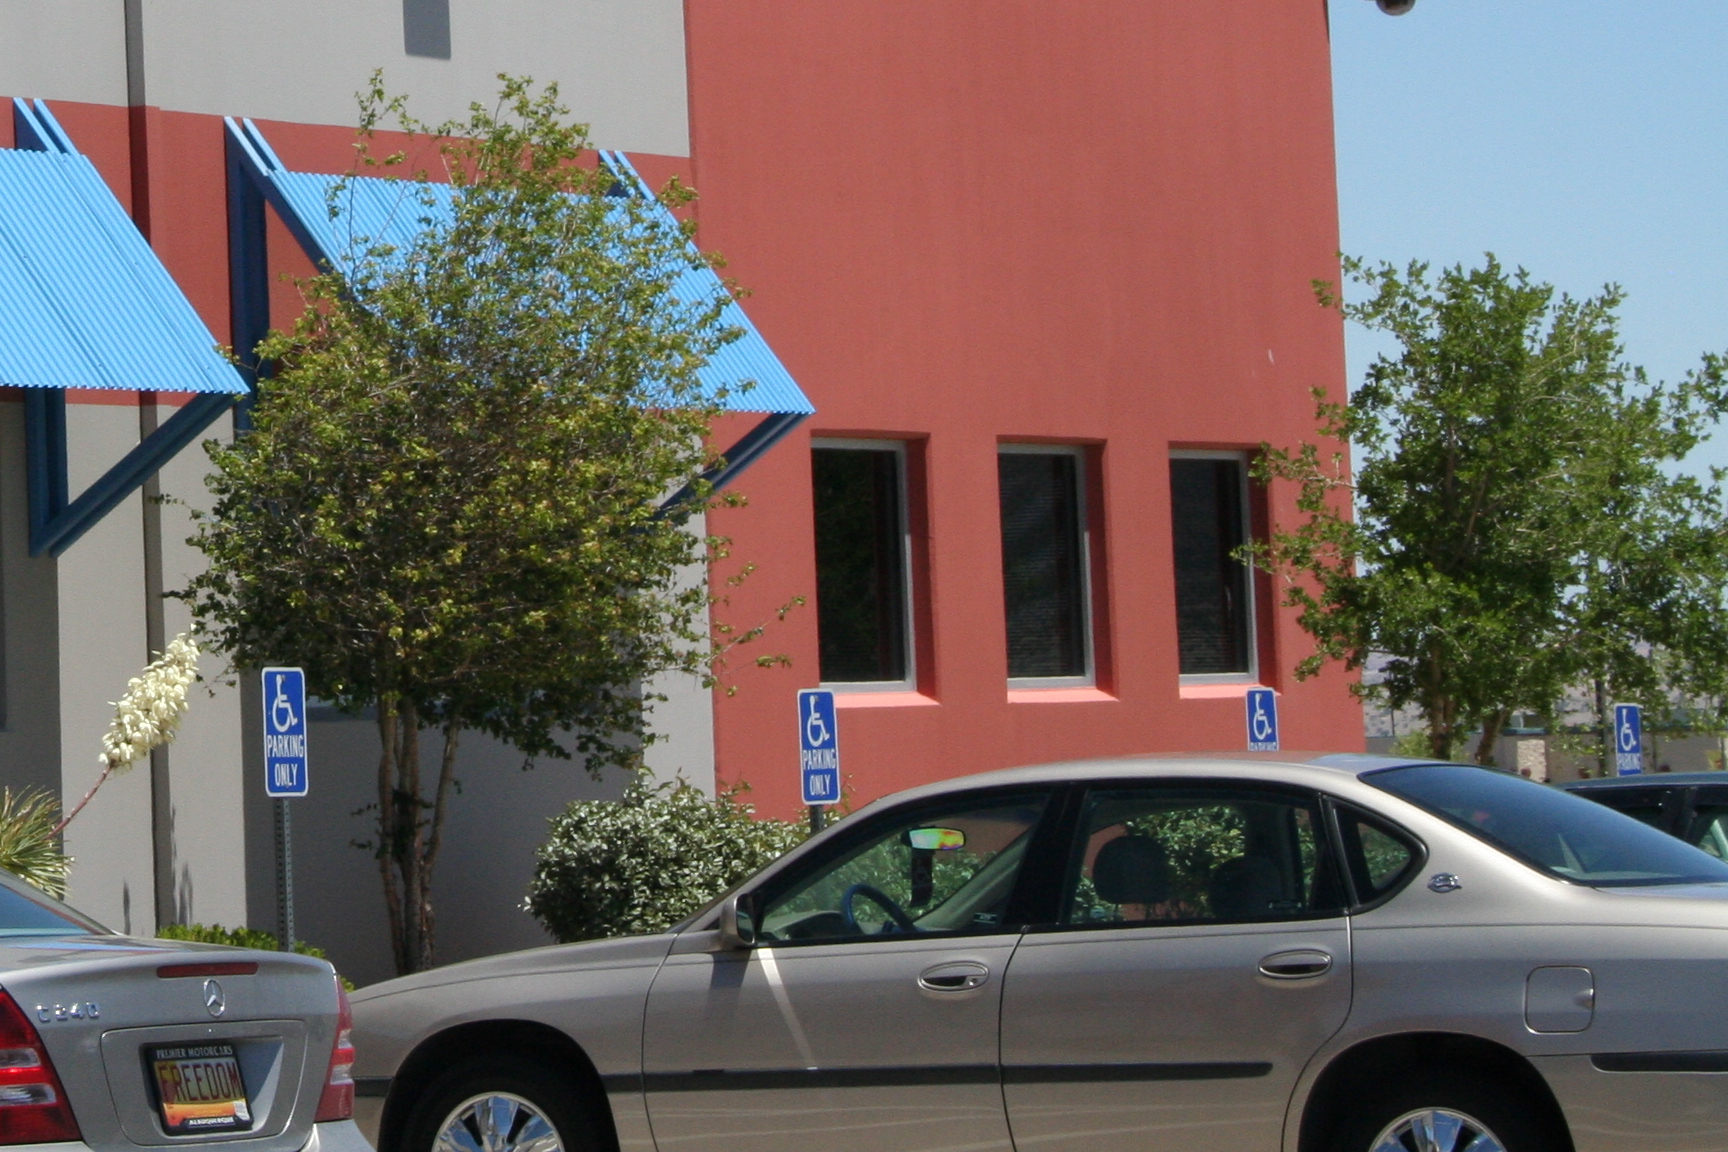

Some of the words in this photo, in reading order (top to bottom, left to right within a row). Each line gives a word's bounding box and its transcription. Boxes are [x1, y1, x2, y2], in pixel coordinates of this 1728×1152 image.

[268, 735, 303, 758] PARKING
[804, 749, 836, 769] PARKING
[275, 764, 298, 787] ONLY
[810, 775, 831, 795] ONLY
[189, 1045, 233, 1057] MOTORCARS
[158, 1062, 244, 1103] FREEDOM
